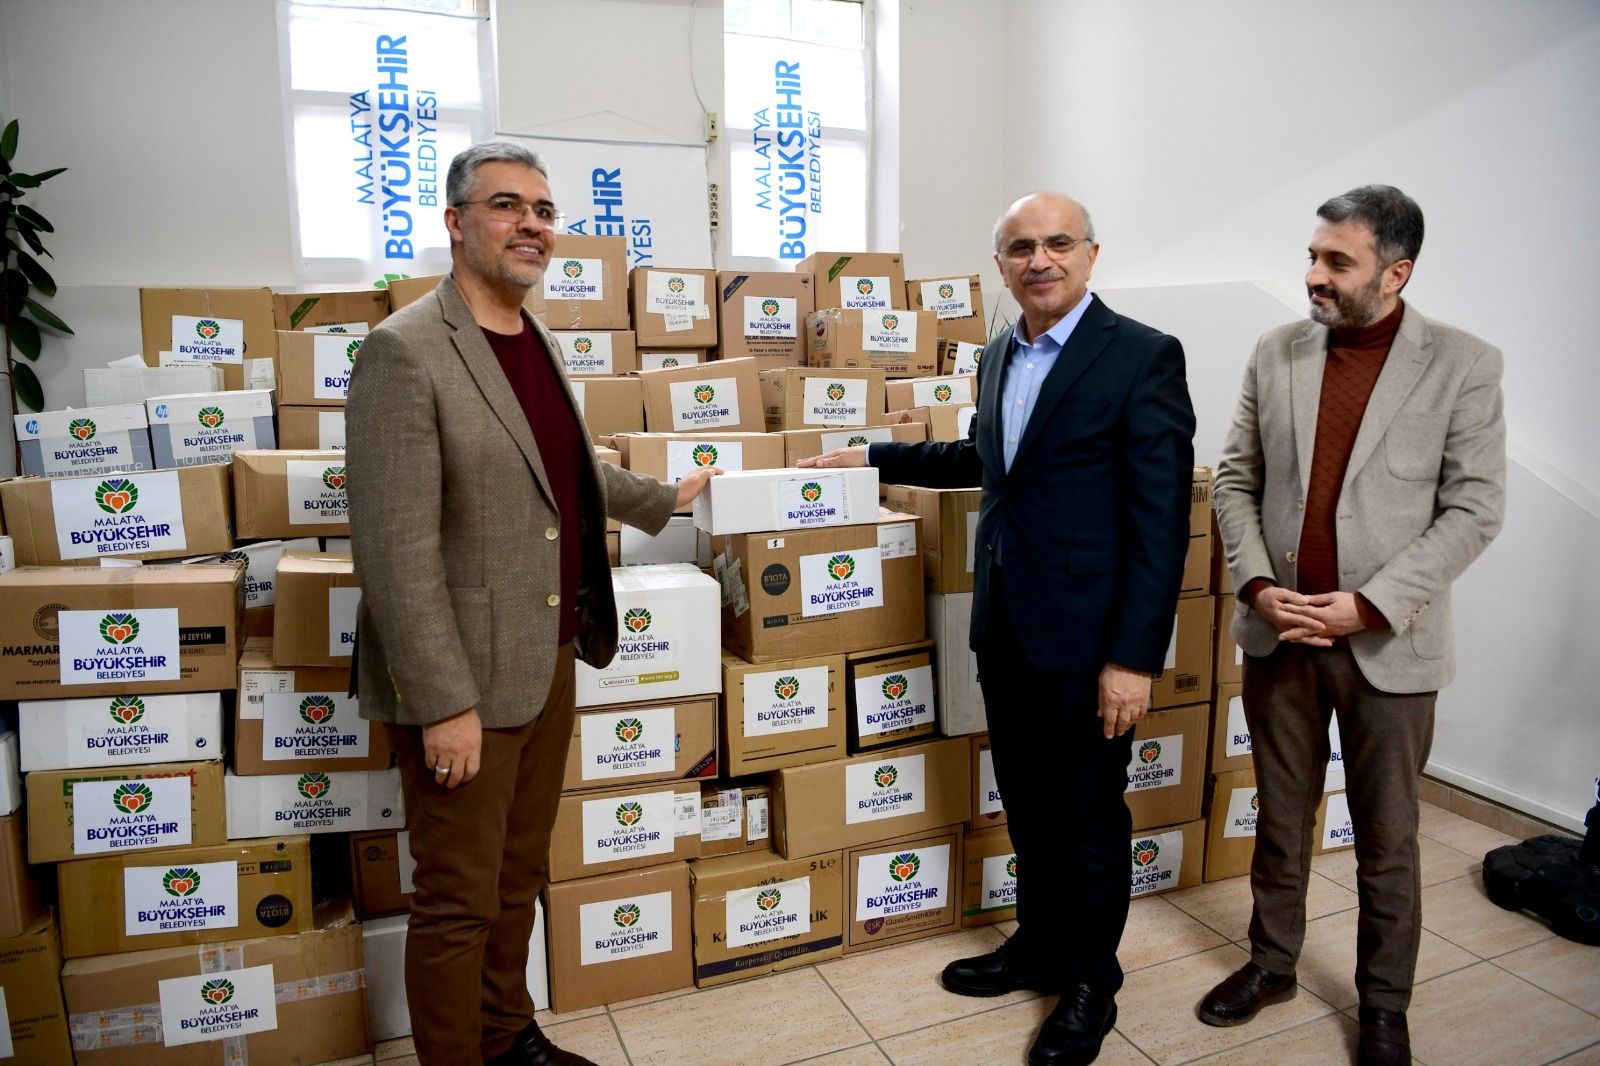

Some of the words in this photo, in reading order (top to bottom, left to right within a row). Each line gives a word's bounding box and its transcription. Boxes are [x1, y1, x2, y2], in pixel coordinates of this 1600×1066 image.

[350, 90, 375, 204] MALATYA
[417, 90, 437, 207] BELEDİYESİ
[753, 107, 771, 210] MALATYA
[807, 111, 822, 214] BELEDİYESİ
[193, 339, 222, 347] MALATYA
[563, 359, 605, 368] ÜYÜKŞEHİR
[198, 429, 229, 437] MALATYA
[69, 440, 102, 449] MALATYA
[799, 502, 825, 510] MALATYA
[94, 515, 145, 527] MALATYA
[71, 523, 171, 544] BÜYÜKŞEHİR
[97, 540, 150, 553] BELEDİYESİ
[825, 581, 859, 591] MALATYA
[621, 634, 654, 642] MALATYA
[96, 647, 144, 656] MALATYA
[73, 655, 167, 671] BÜYÜKŞEHİR
[97, 670, 146, 680] BELEDİYESİ
[772, 700, 802, 708] MALATYA
[880, 700, 912, 711] MALATYA
[107, 726, 149, 735] MALATYA
[295, 725, 339, 735] MALATYA
[612, 743, 646, 752] MALATYA
[1135, 763, 1163, 773] MALATYA
[1127, 767, 1174, 783] ÜYÜKŞEHİR
[872, 787, 901, 797] MALATYA
[294, 800, 334, 809] MALATYA
[109, 815, 157, 826] MALATYA
[87, 822, 179, 841] BÜYÜKŞEHİR
[613, 825, 646, 835] MALATYA
[110, 837, 158, 848] BELEDİYESİ
[809, 861, 817, 871] 5
[1131, 865, 1159, 876] ALATYA
[1130, 869, 1172, 887] ÜKŞEHİR
[884, 881, 922, 893] MALATYA
[160, 898, 205, 908] MALATYA
[866, 887, 938, 908] BÜYÜKŞEHİR
[884, 901, 922, 914] BELEDİYESİ
[138, 905, 226, 923] BÜYÜKŞEHİR
[754, 910, 784, 921] MALATYA
[159, 920, 206, 930] BELEDİYESİ
[611, 926, 644, 937] MALATYA
[199, 1003, 240, 1016] MALATYA
